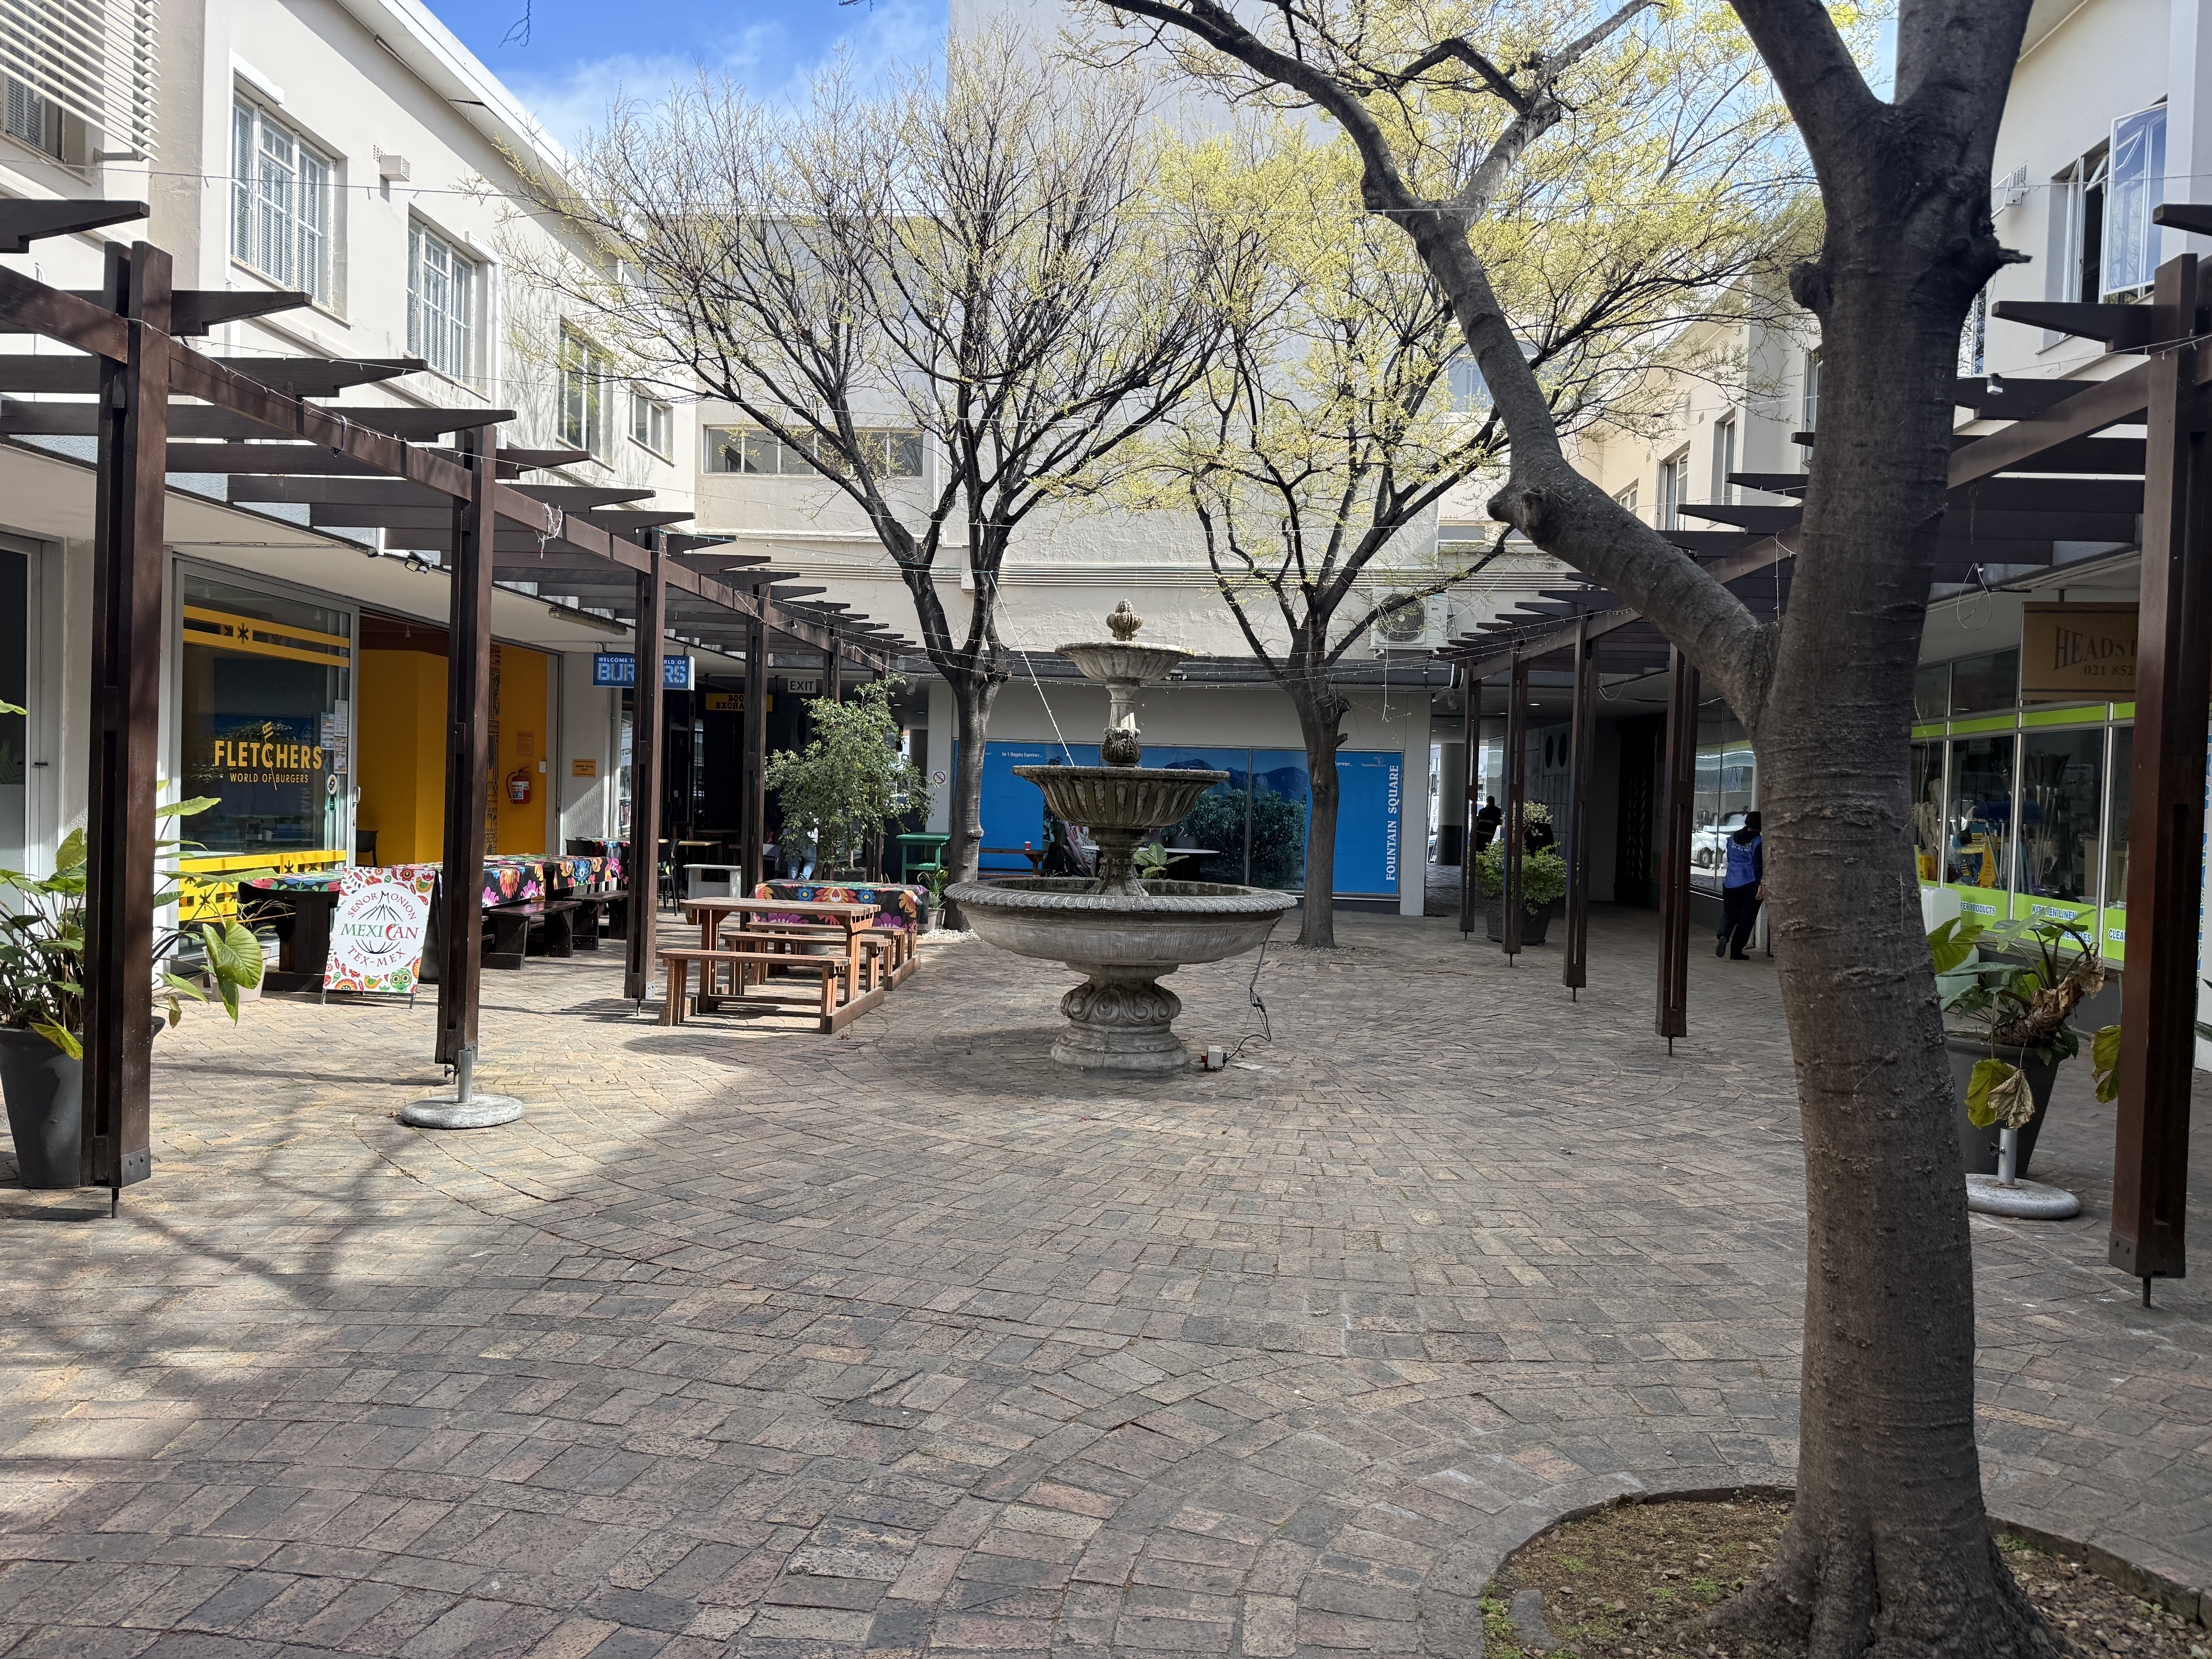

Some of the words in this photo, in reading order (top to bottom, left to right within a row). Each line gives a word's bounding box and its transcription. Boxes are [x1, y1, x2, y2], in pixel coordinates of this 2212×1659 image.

[598, 663, 686, 683] BURRS
[2084, 665, 2106, 675] 021
[2112, 665, 2134, 675] 852
[790, 681, 814, 690] EXIT
[215, 740, 322, 769] FLETCHERS
[230, 773, 258, 782] WORLD
[263, 774, 272, 783] OF
[276, 774, 308, 783] BURGERS
[1388, 766, 1400, 814] SQUARE
[1386, 821, 1396, 881] FOUNTAIN
[348, 893, 378, 918] SEÑOR
[1971, 903, 1996, 915] PRODUCTS
[2058, 909, 2077, 921] LINEN
[339, 923, 419, 941] MEXICAN
[2109, 929, 2125, 941] CLEA
[347, 945, 406, 967] TEX-MEX
